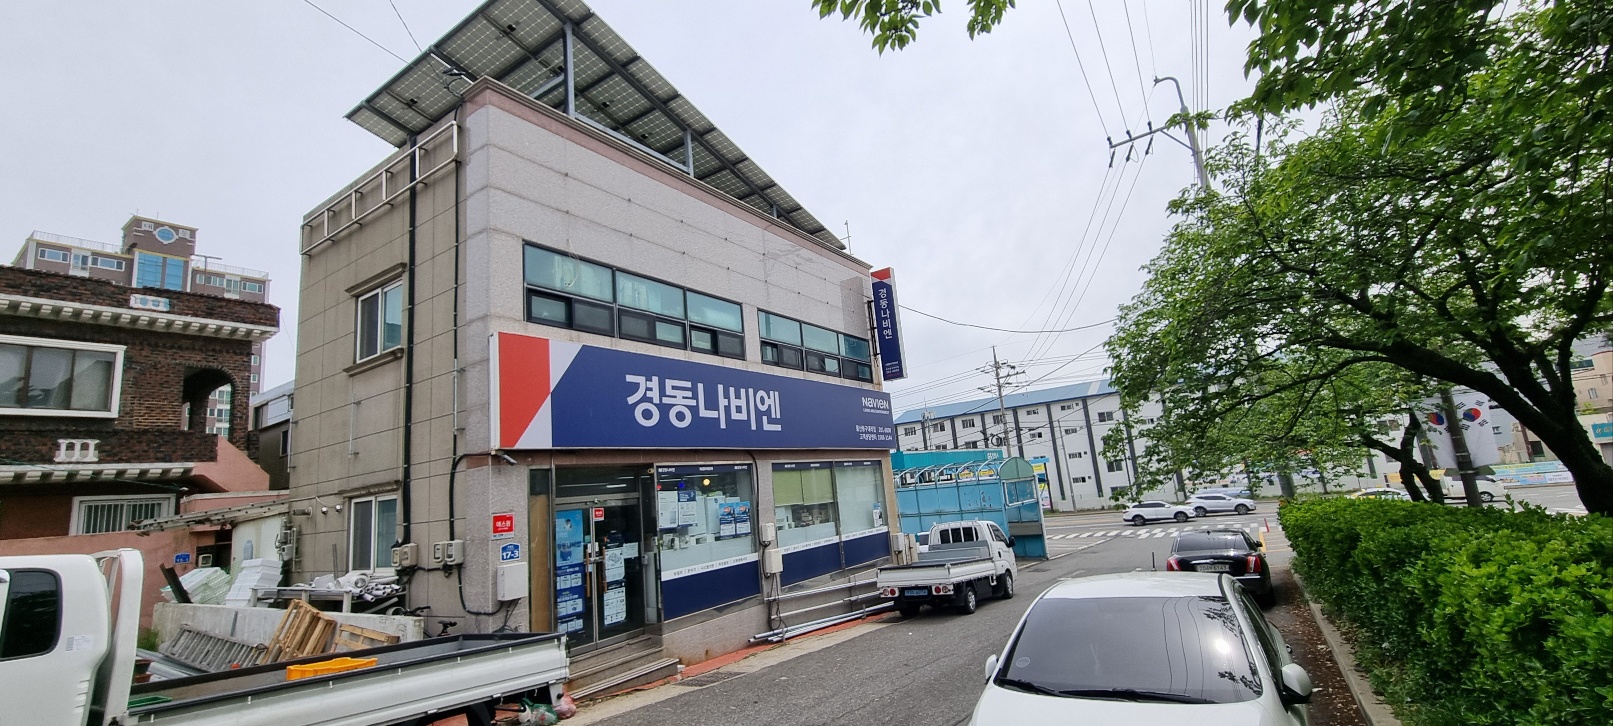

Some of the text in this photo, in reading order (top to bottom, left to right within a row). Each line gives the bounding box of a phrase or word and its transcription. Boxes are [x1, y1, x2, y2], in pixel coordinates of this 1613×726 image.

[878, 288, 893, 339] 경동나비엔
[625, 374, 782, 432] 경동나비엔
[502, 550, 519, 560] 17-3
